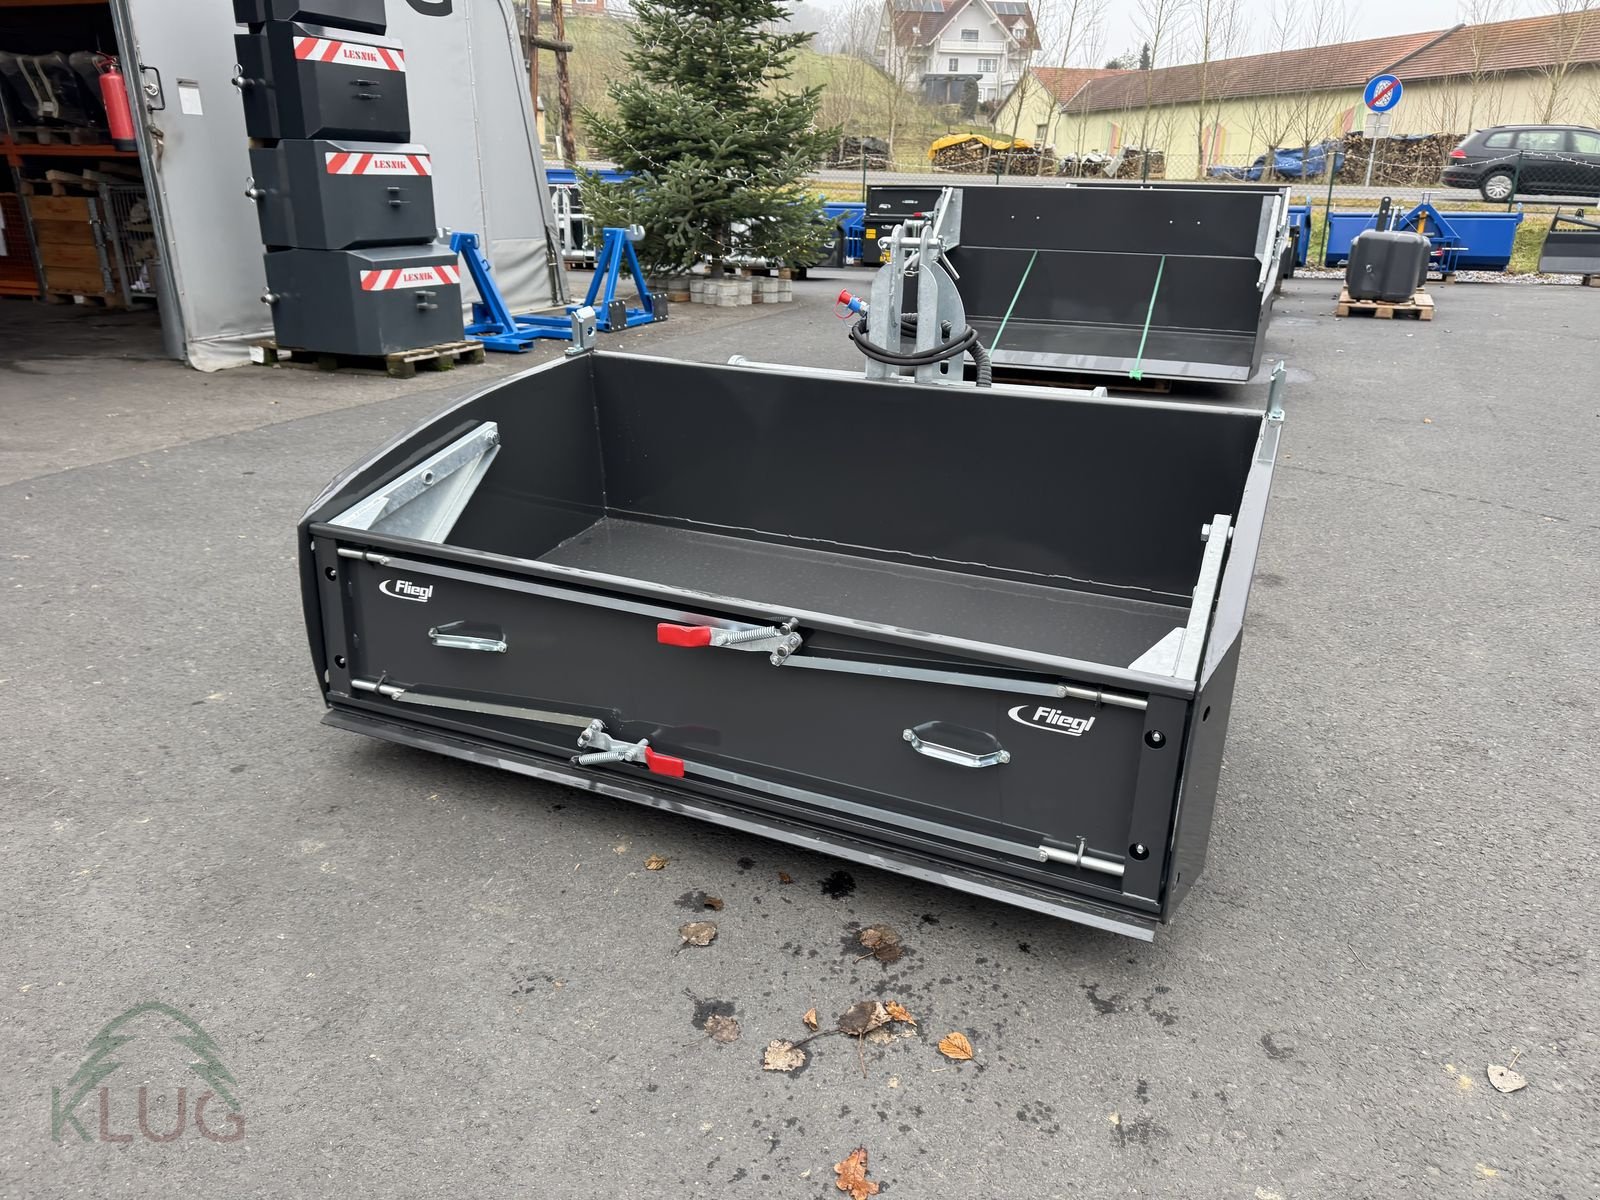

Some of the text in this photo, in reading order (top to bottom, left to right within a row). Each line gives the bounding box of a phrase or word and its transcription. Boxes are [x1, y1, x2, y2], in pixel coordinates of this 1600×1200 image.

[343, 48, 378, 62] LESNIK
[374, 159, 408, 170] LESNIK
[403, 272, 434, 282] LESNIK
[395, 579, 434, 600] Fliegl
[1032, 706, 1096, 734] Fliegl
